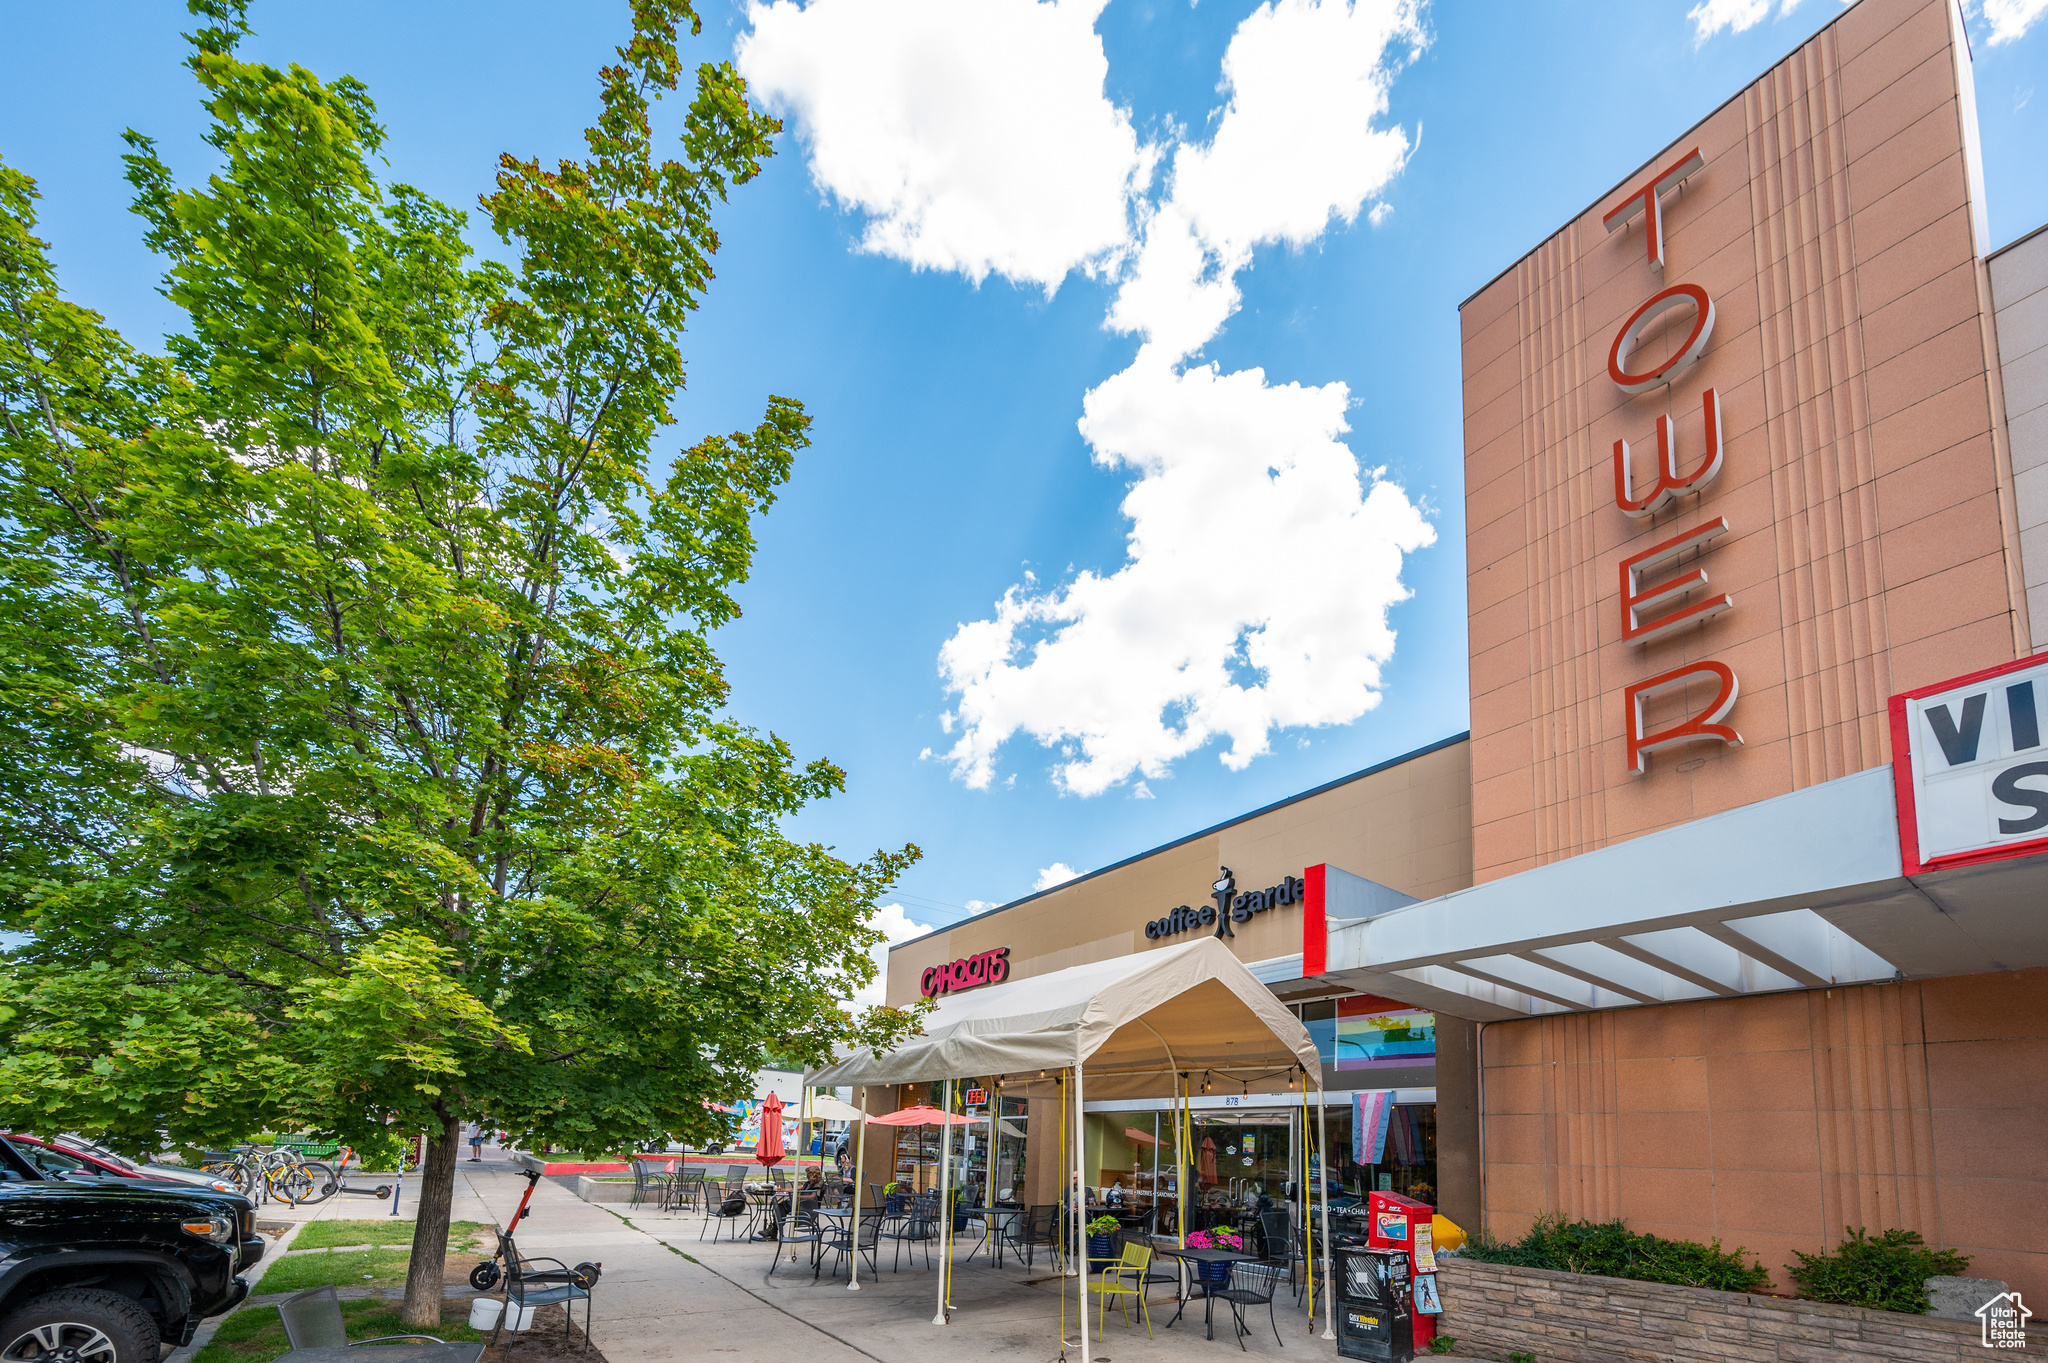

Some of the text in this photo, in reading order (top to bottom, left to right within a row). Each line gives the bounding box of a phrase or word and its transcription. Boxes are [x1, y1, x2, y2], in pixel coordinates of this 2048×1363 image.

[1602, 145, 1745, 775] TOWER
[1145, 875, 1304, 940] coffee garde
[920, 946, 1011, 997] CAHOOTS
[1225, 1097, 1239, 1106] 878
[1306, 1203, 1366, 1216] SPREO TEA CHAI
